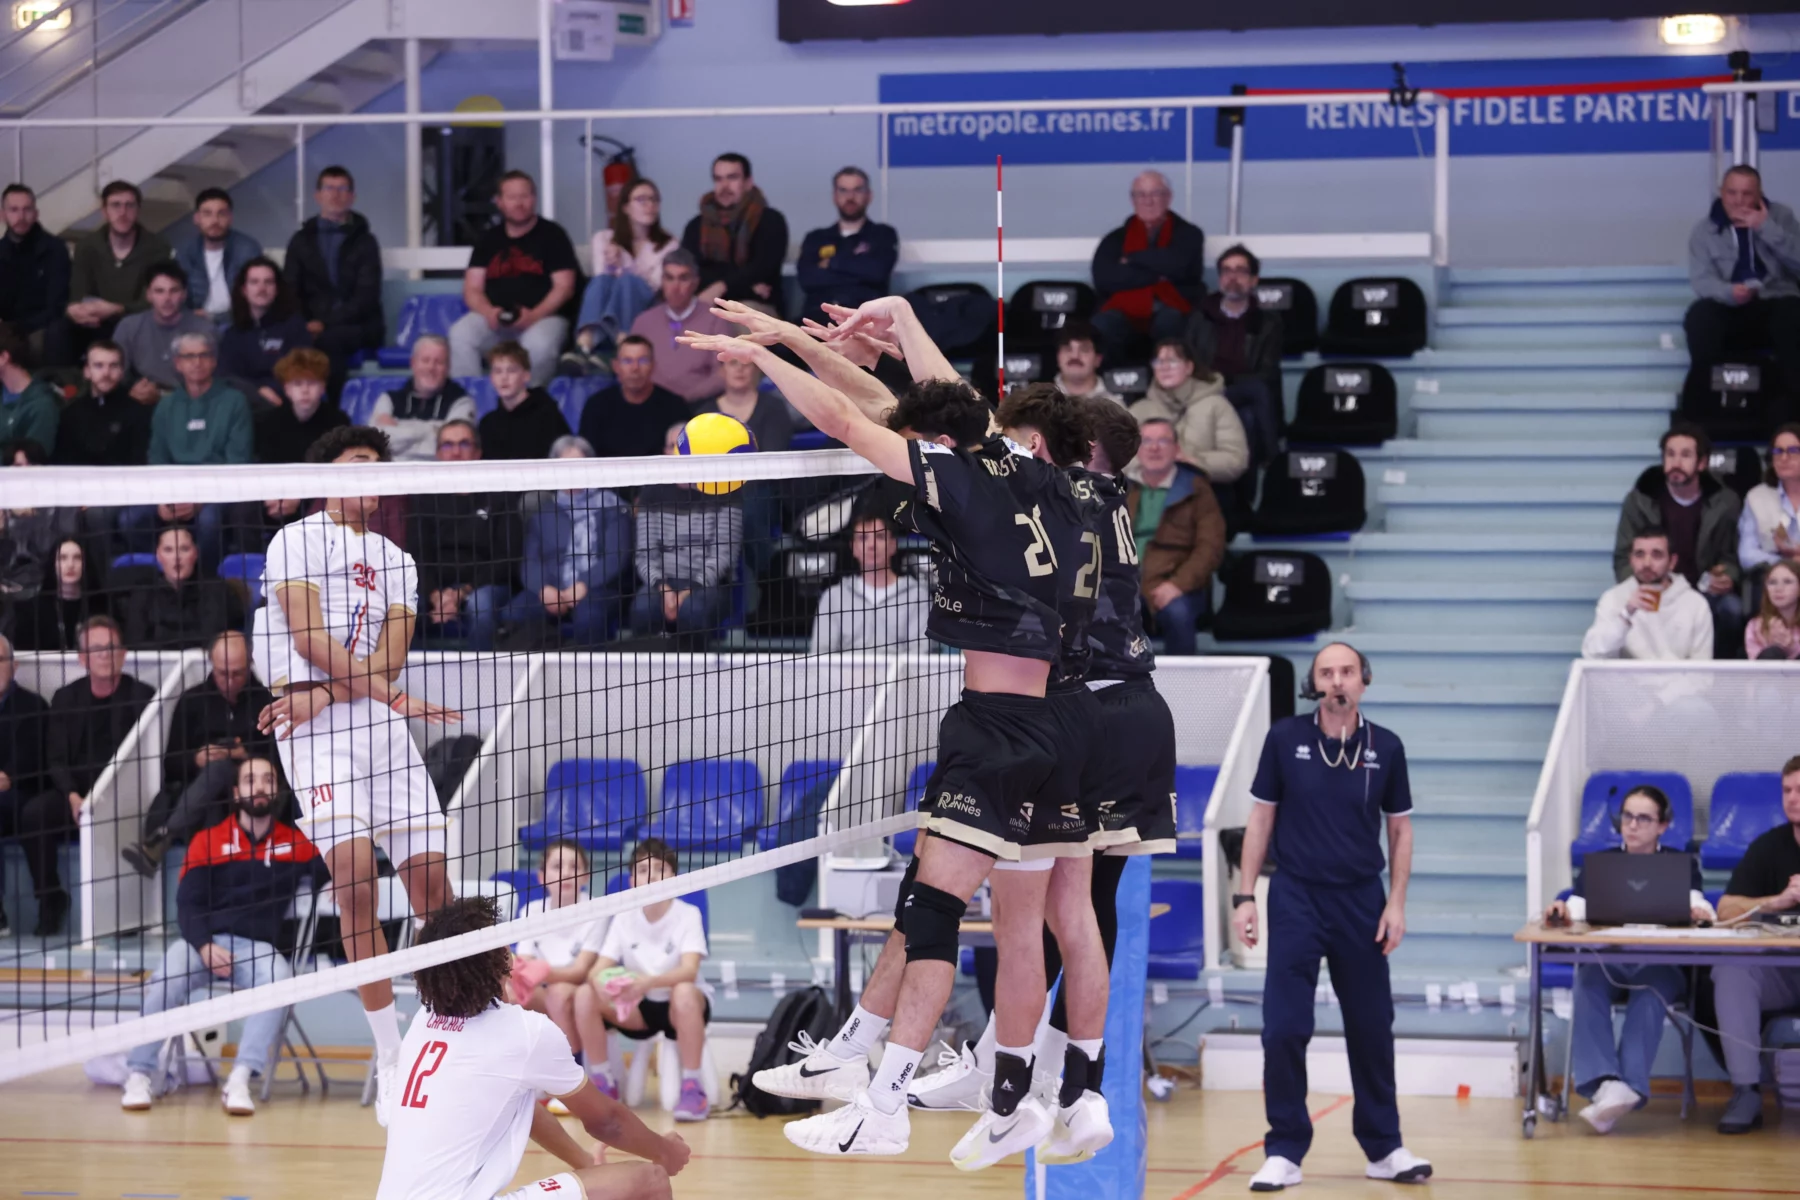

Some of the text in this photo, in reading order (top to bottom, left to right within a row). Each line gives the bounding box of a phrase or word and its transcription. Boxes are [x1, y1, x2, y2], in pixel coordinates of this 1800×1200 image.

[1306, 98, 1437, 130] RENNES
[1453, 93, 1566, 127] FIDELE
[893, 107, 1174, 141] metropole.rennes.fr
[1362, 288, 1388, 302] VIP
[1335, 373, 1361, 387] VIP
[1723, 370, 1749, 384] VIP
[1299, 457, 1326, 471] VIP
[1014, 503, 1058, 577] 21
[1112, 504, 1138, 565] 10
[1267, 562, 1294, 577] VIP
[847, 1017, 861, 1037] CRAFT
[401, 1040, 449, 1109] 12
[897, 1062, 914, 1085] CRAFT
